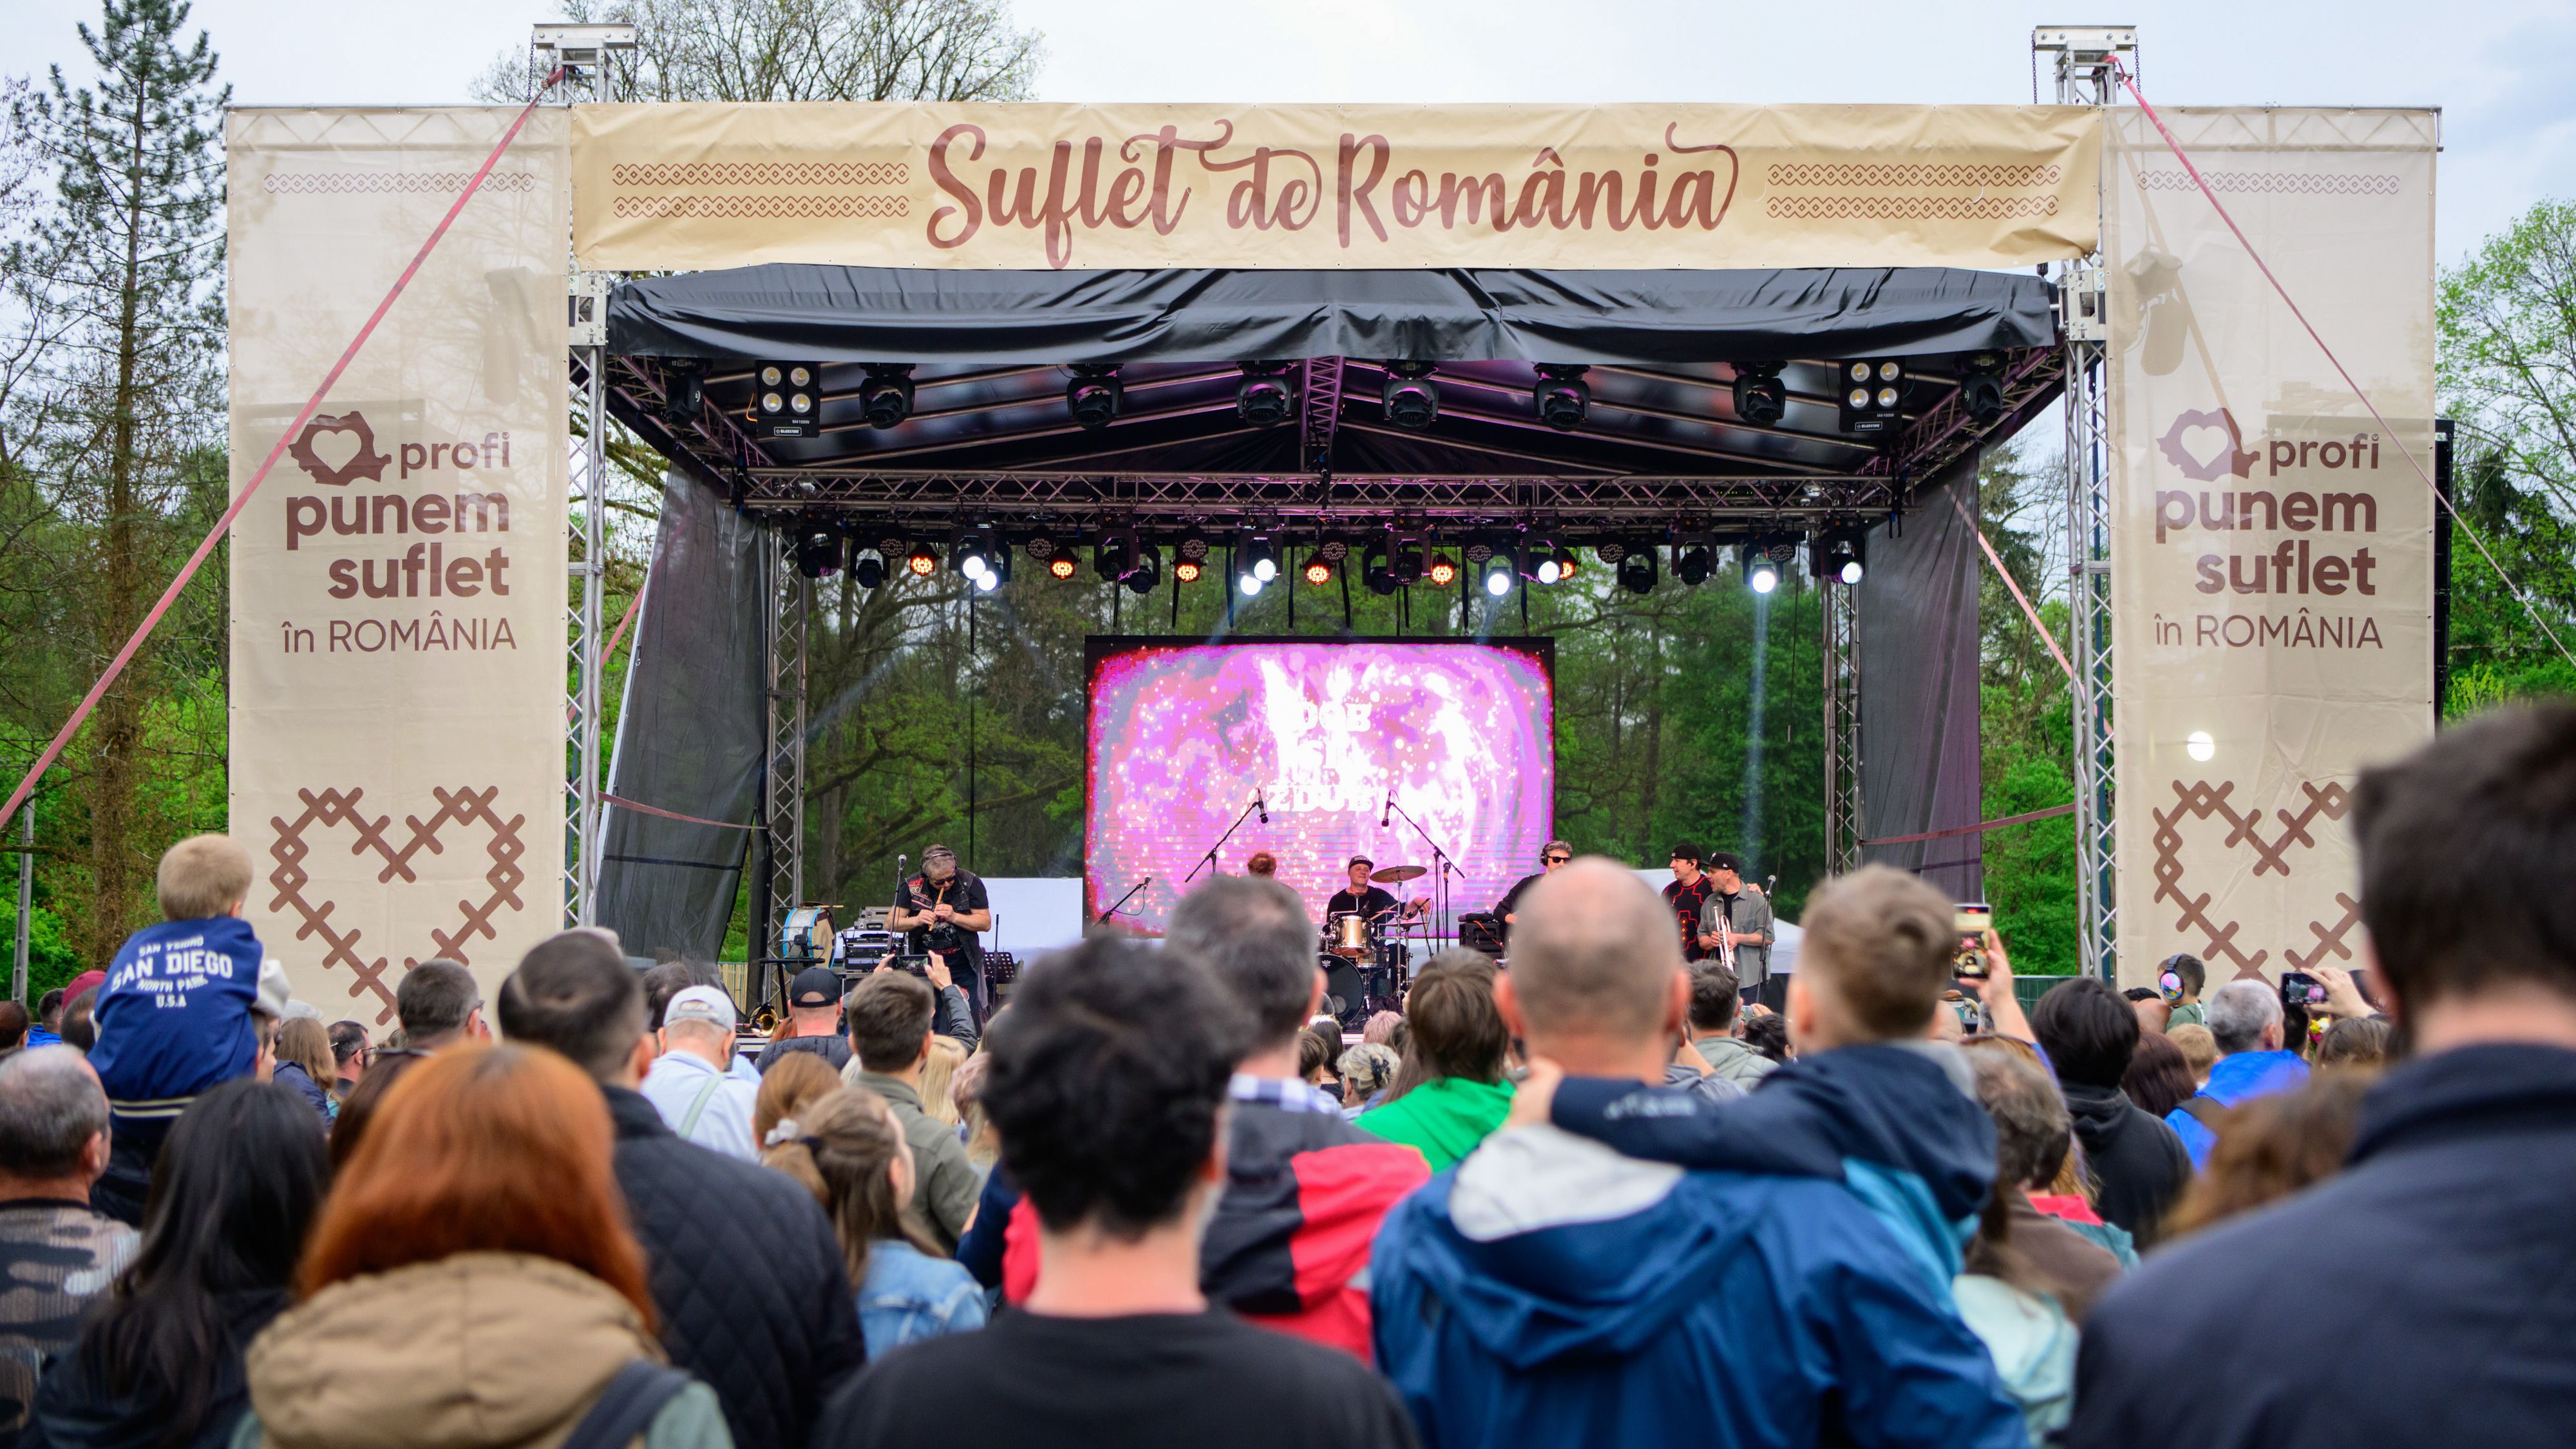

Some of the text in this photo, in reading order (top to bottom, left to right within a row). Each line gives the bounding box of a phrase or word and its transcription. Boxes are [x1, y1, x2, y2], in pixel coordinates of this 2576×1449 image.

[927, 119, 1739, 269] Suflet de România
[401, 432, 510, 479] profi
[2269, 433, 2379, 477] profi
[287, 492, 509, 551] punem
[2155, 490, 2377, 544] punem
[328, 542, 509, 599] suflet
[2195, 540, 2376, 596] suflet
[281, 611, 517, 653] în ROMÂNIA
[2154, 607, 2383, 649] în ROMÂNIA
[111, 949, 232, 992] SAN DIEGO
[138, 943, 161, 957] SAN
[137, 978, 174, 992] NORTH
